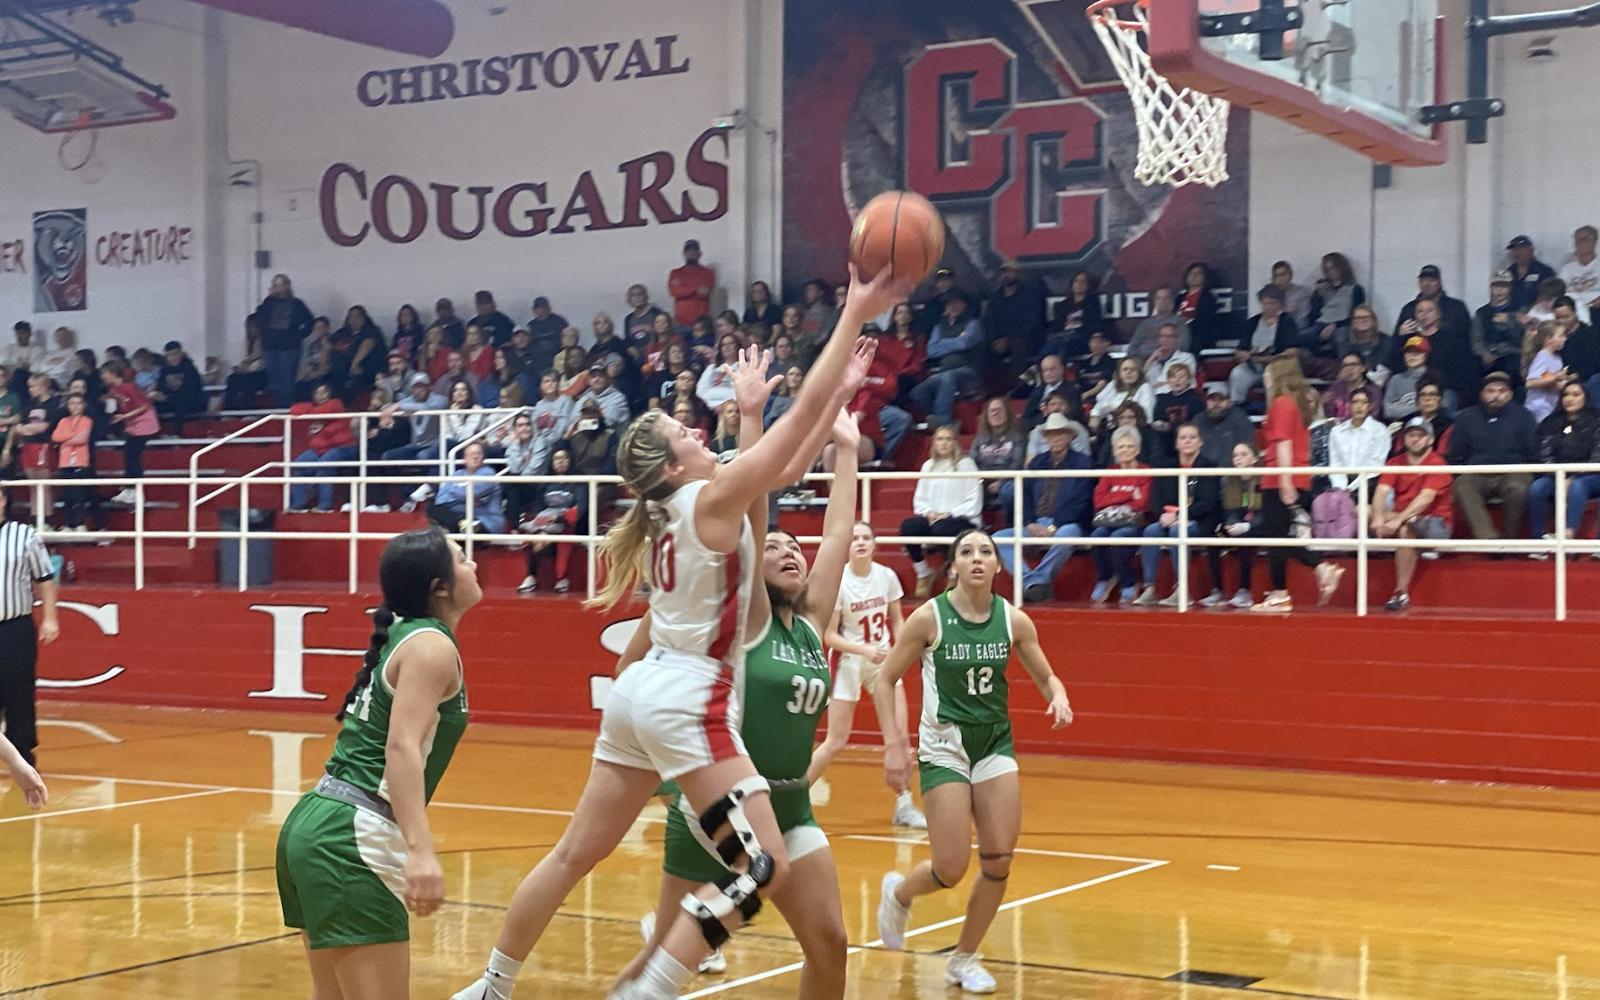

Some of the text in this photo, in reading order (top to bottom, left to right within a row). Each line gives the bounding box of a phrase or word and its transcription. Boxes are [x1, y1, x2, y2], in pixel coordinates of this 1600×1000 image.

[357, 34, 691, 107] CHRISTOVAL
[319, 125, 731, 247] COUGARS
[95, 225, 192, 269] CREATURE
[858, 611, 884, 643] 13
[944, 642, 1008, 660] LADY EAGLES
[786, 674, 826, 715] 30
[966, 666, 994, 696] 12
